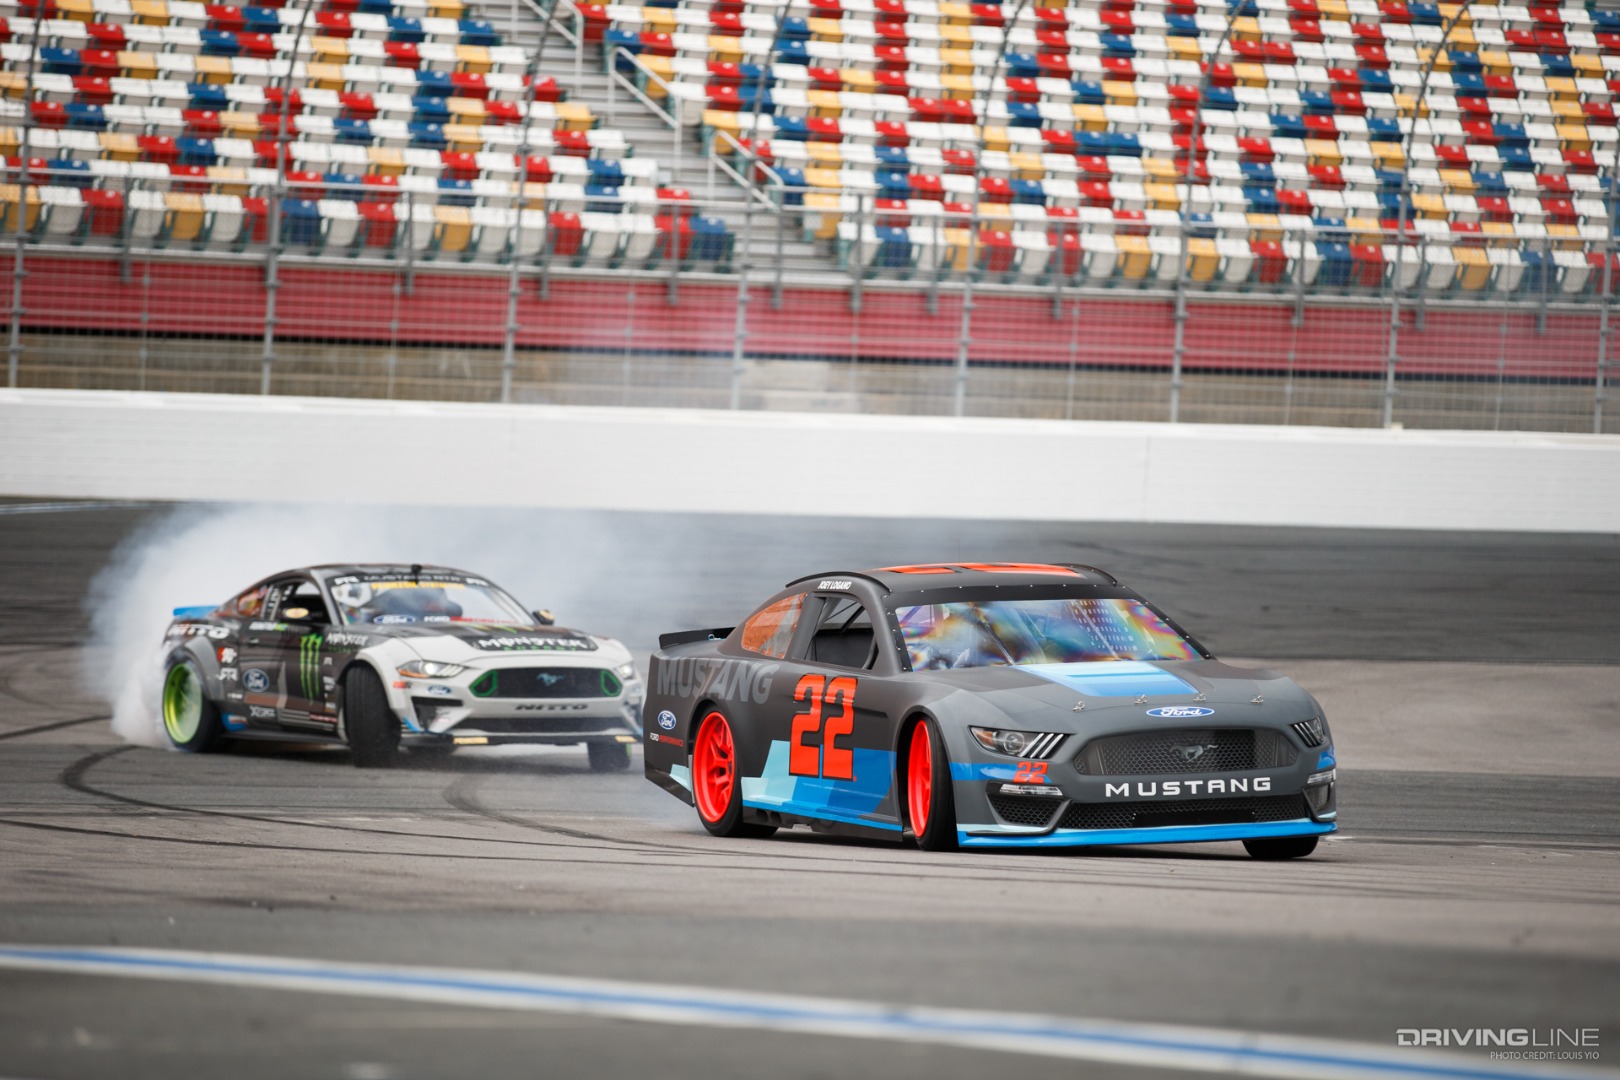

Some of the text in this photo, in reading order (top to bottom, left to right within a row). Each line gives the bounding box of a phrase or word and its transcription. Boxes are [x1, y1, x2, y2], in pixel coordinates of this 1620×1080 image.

[817, 581, 852, 589] JOEY LOGANO
[478, 637, 588, 649] MONSTER
[657, 658, 781, 704] MUSTANG
[1160, 707, 1203, 717] Ford
[789, 673, 858, 781] 22
[1012, 761, 1049, 785] 22
[1105, 777, 1271, 797] MUSTANG
